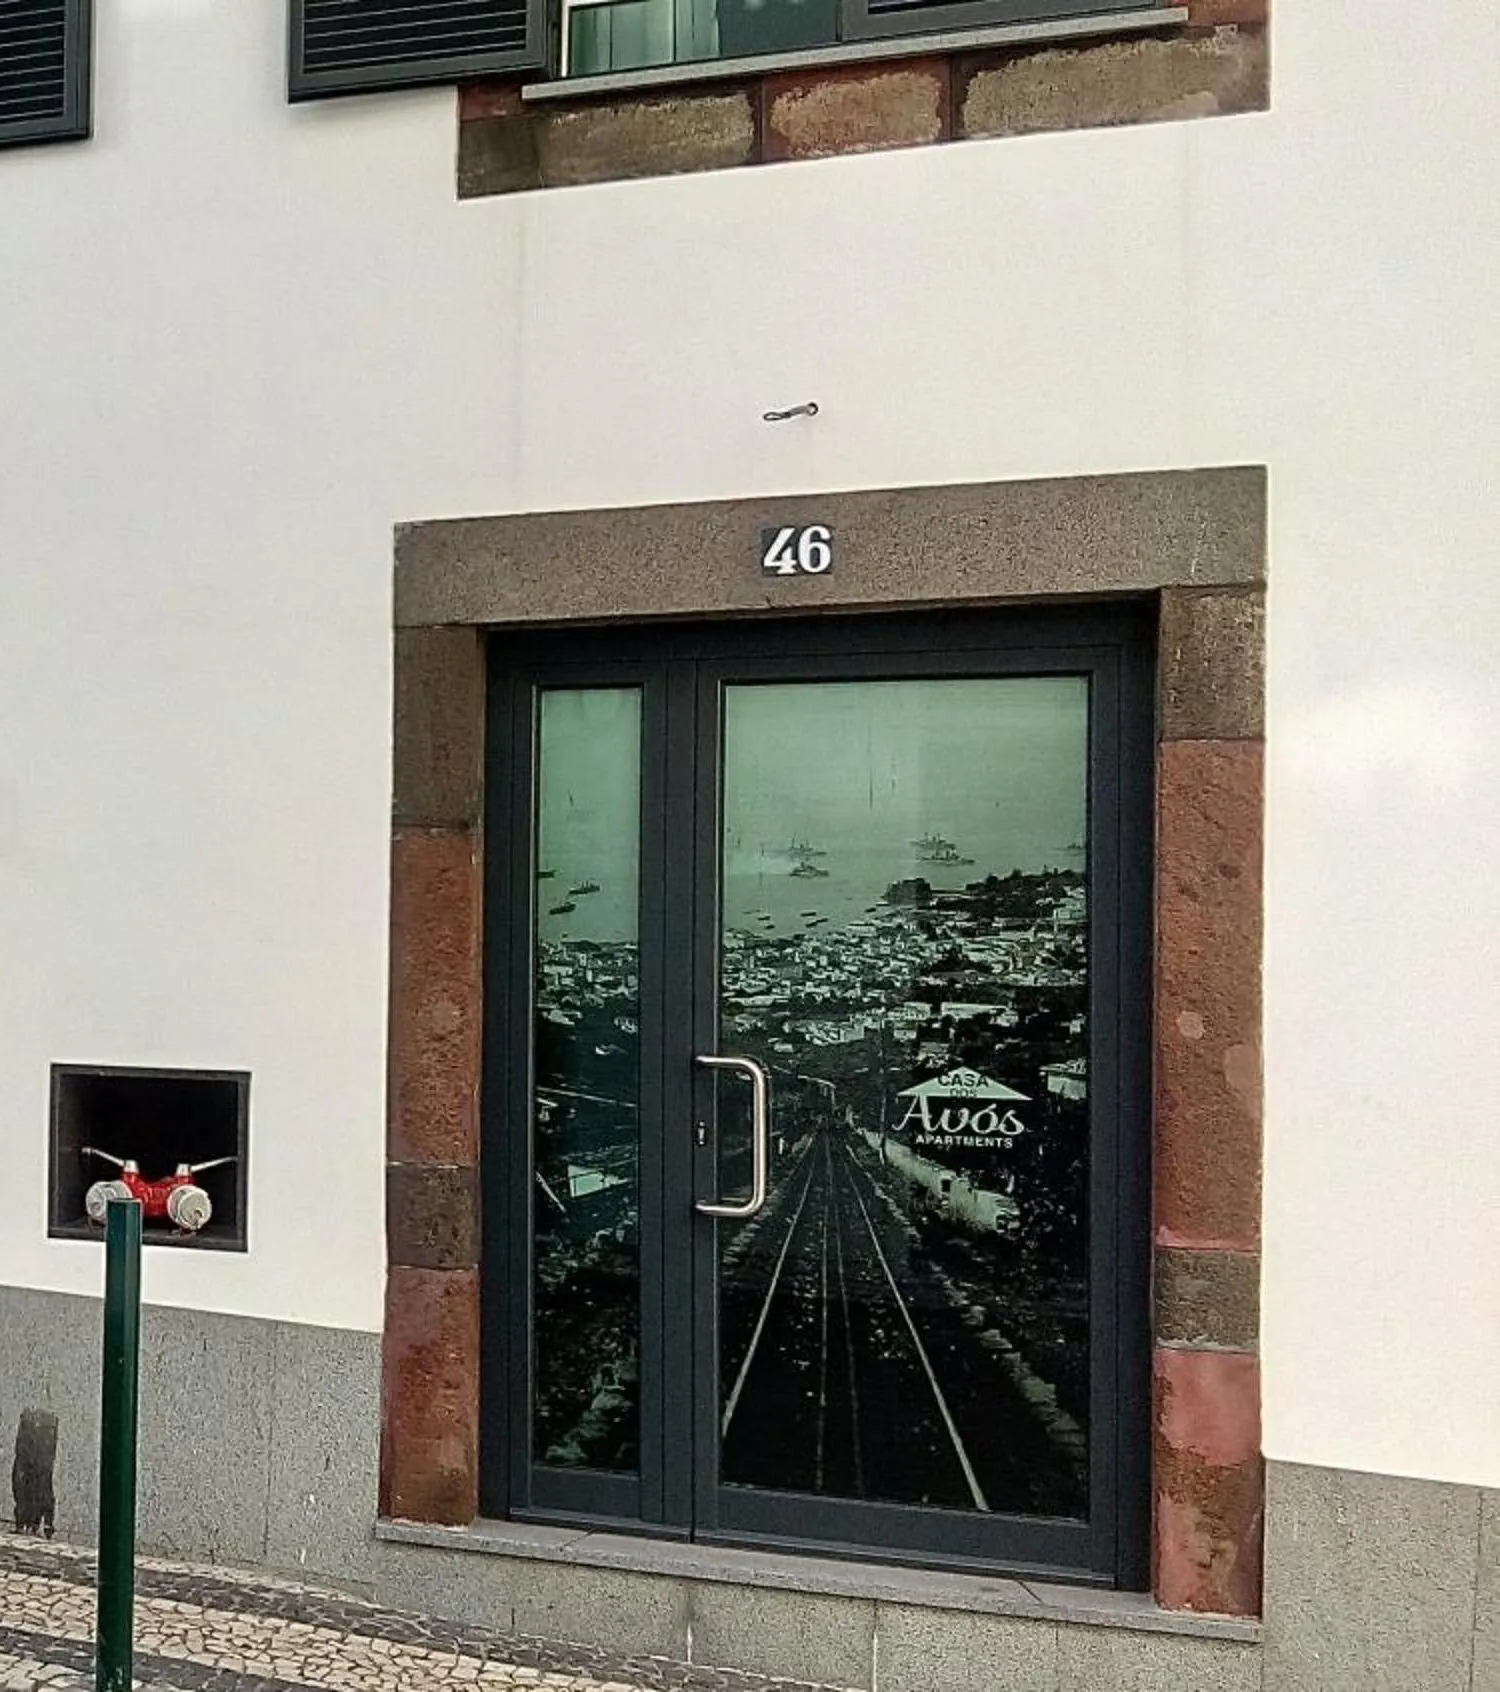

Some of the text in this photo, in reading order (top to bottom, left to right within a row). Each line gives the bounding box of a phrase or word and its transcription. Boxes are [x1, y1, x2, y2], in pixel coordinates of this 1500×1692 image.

[763, 525, 831, 574] 46
[937, 1073, 989, 1088] CASA
[891, 1095, 1026, 1135] Avós
[915, 1134, 1014, 1149] APARTMENTS
